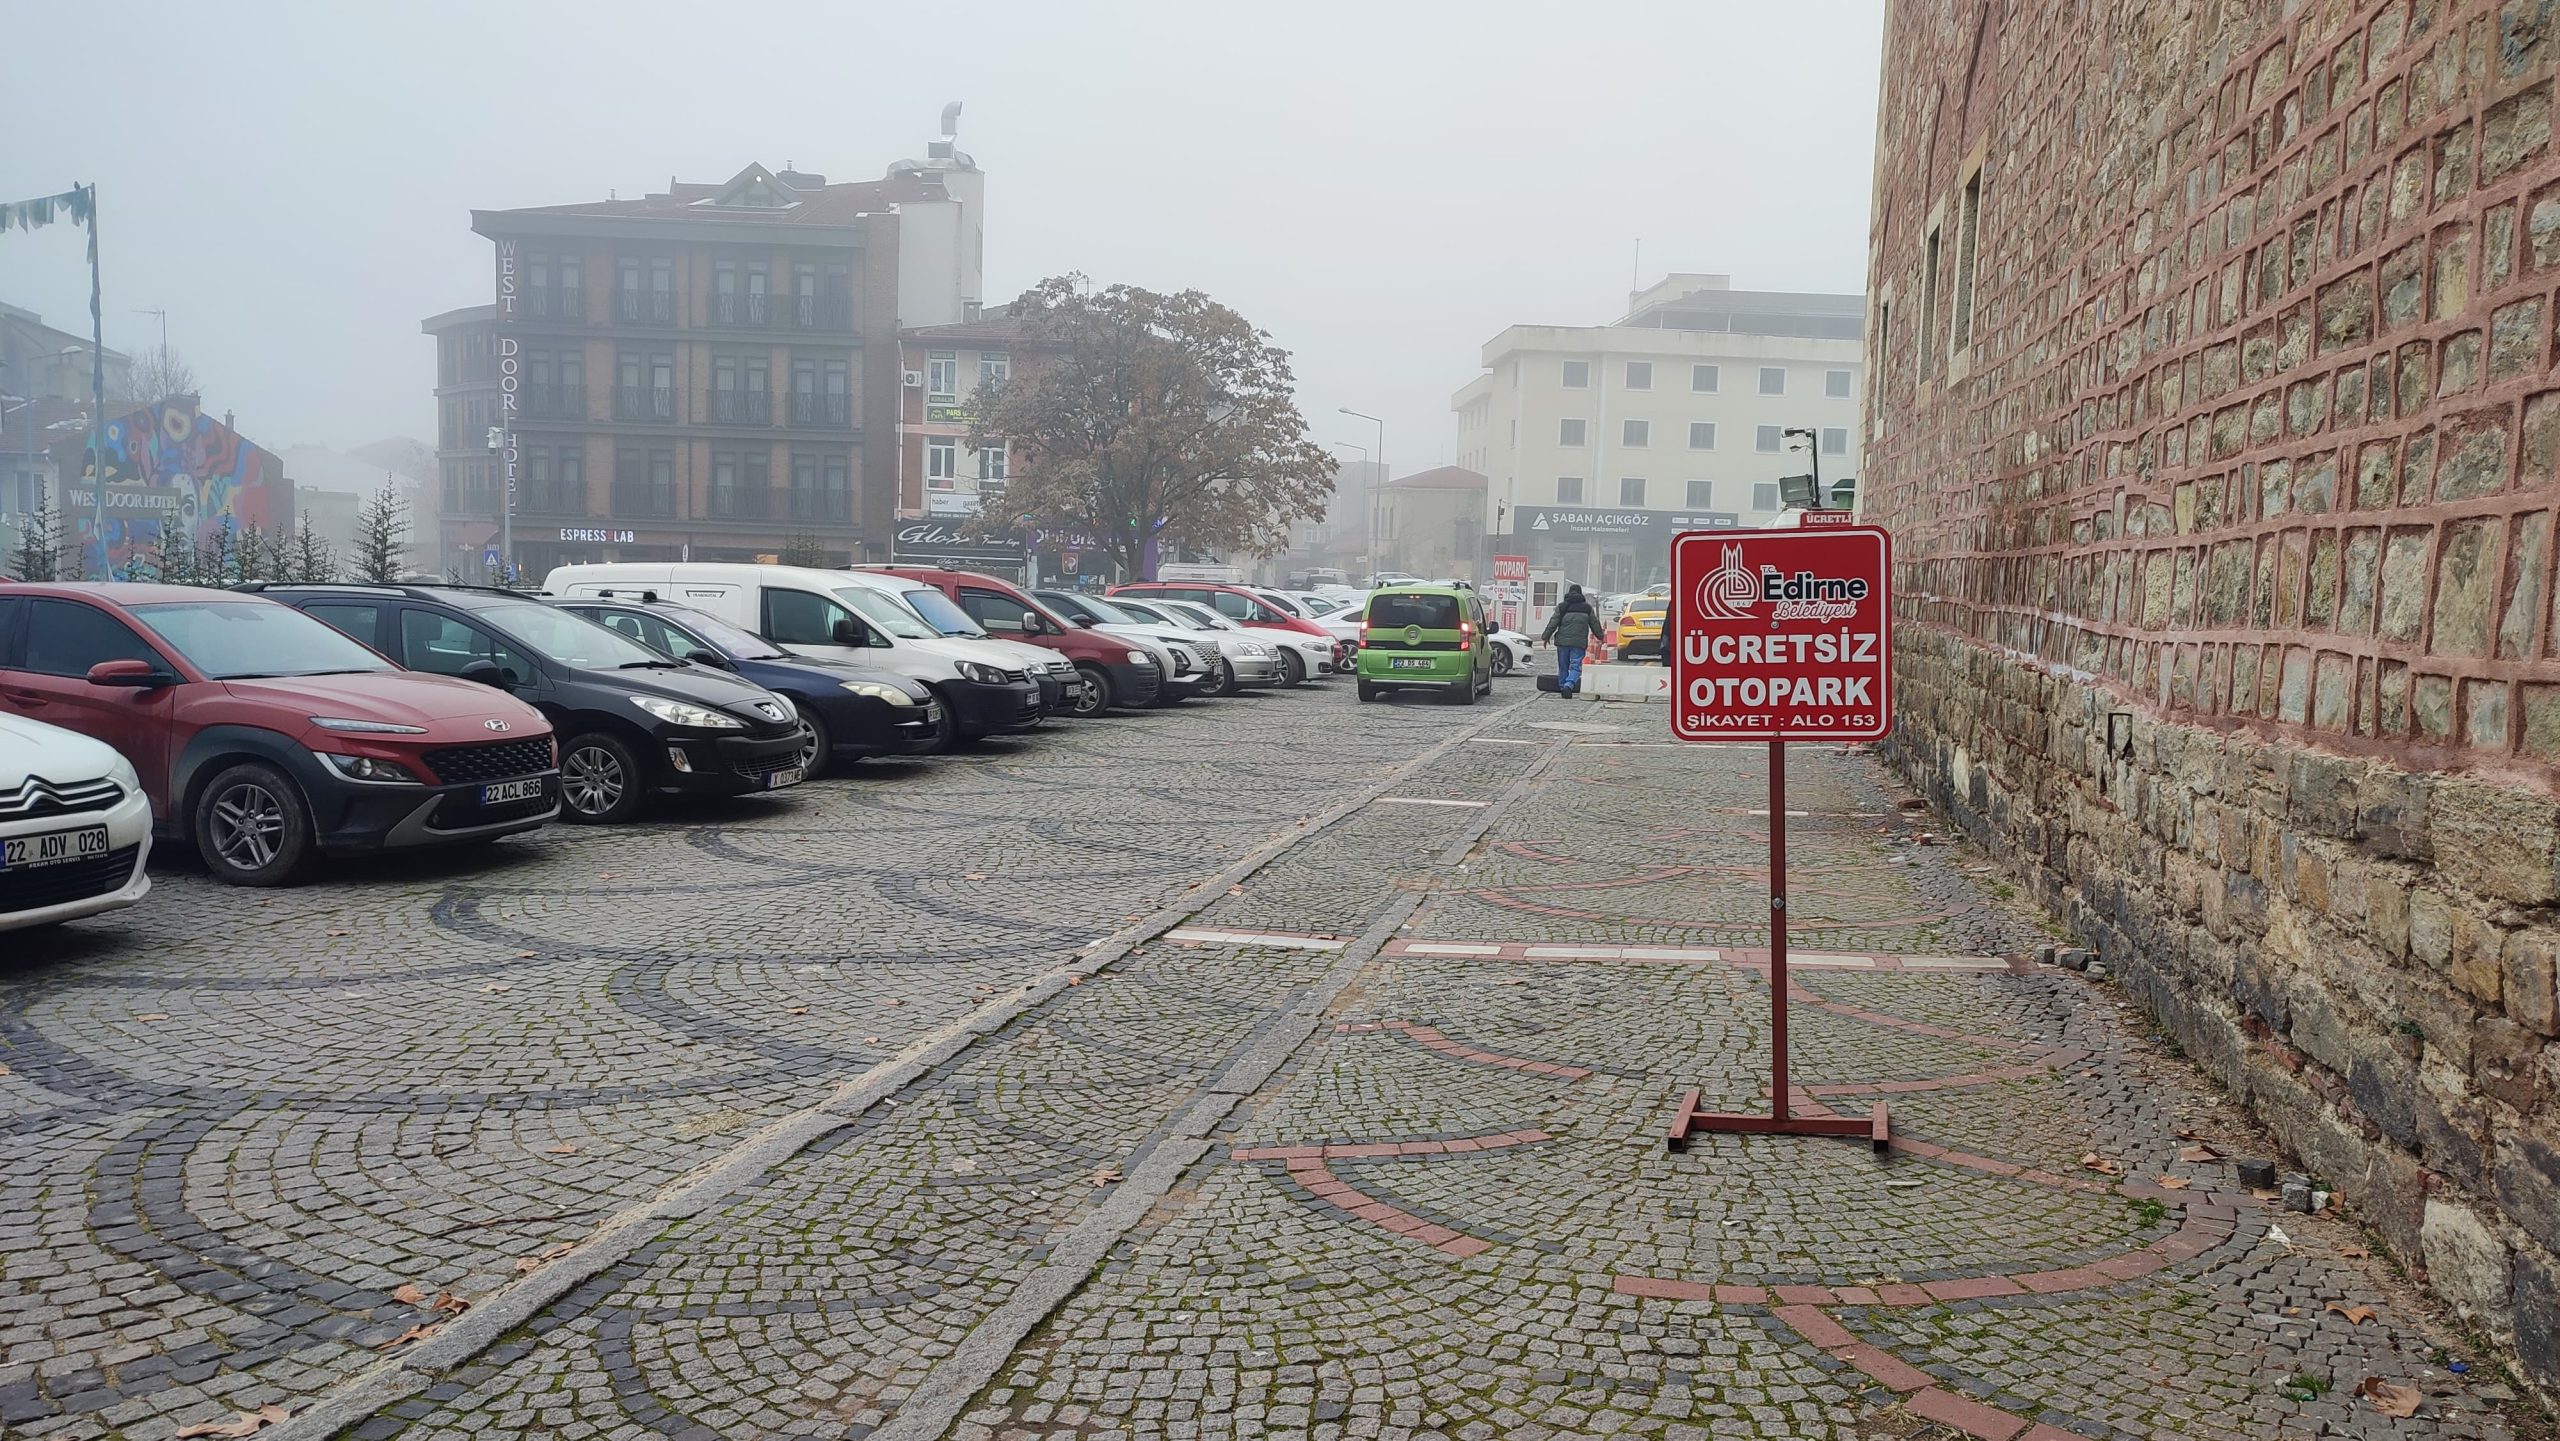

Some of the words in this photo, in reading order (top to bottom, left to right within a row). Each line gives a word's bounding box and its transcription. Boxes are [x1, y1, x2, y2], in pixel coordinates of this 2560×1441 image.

[501, 339, 518, 410] DOOR
[69, 489, 96, 507] WES
[105, 491, 144, 508] DOOR
[144, 495, 180, 509] HOTEL
[1552, 513, 1593, 524] ŞABAN
[1596, 514, 1649, 527] AÇIKGÖZ
[1494, 561, 1526, 577] OTOPARK
[1763, 571, 1867, 601] Edirne
[1773, 602, 1857, 624] Belediyesi
[1684, 627, 1878, 665] ÜCRETSİZ
[1689, 677, 1873, 707] OTOPARK
[1687, 713, 1773, 729] ŞİKAYET
[1790, 715, 1835, 726] ALO
[1841, 714, 1875, 726] 153
[486, 786, 499, 802] 22
[502, 783, 521, 800] ACL
[522, 780, 541, 796] 866
[6, 841, 26, 863] 22
[40, 834, 67, 858] ADV
[79, 830, 105, 852] 028
